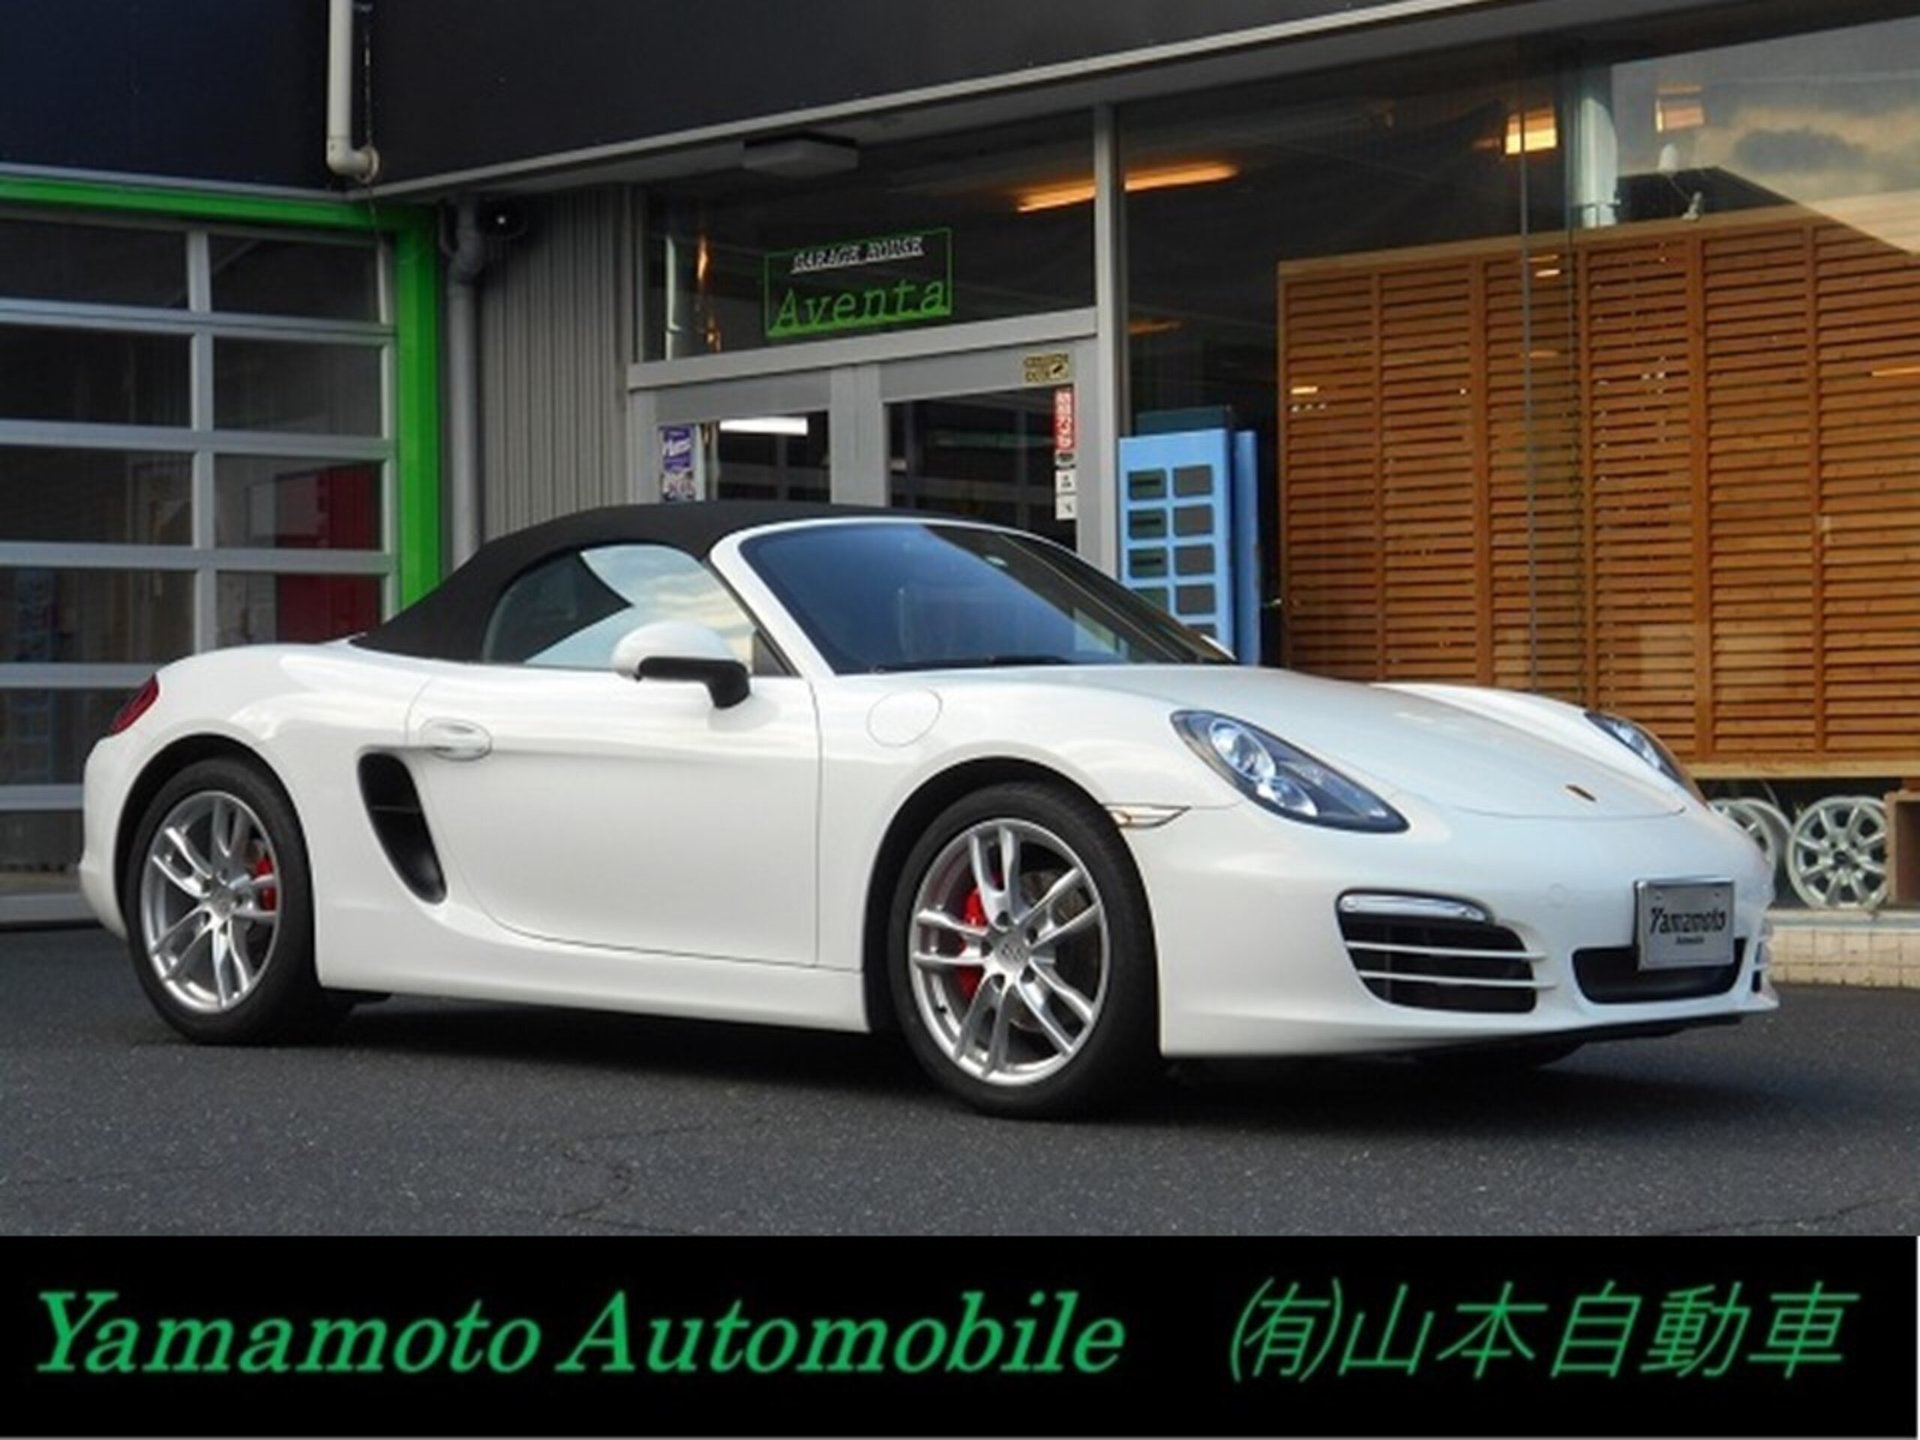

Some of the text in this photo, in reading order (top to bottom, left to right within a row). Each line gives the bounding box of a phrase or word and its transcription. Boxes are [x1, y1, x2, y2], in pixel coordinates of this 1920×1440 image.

[791, 236, 924, 273] GARAGE HOUSE
[774, 278, 946, 328] Aventa
[1649, 906, 1727, 935] Yamamoto
